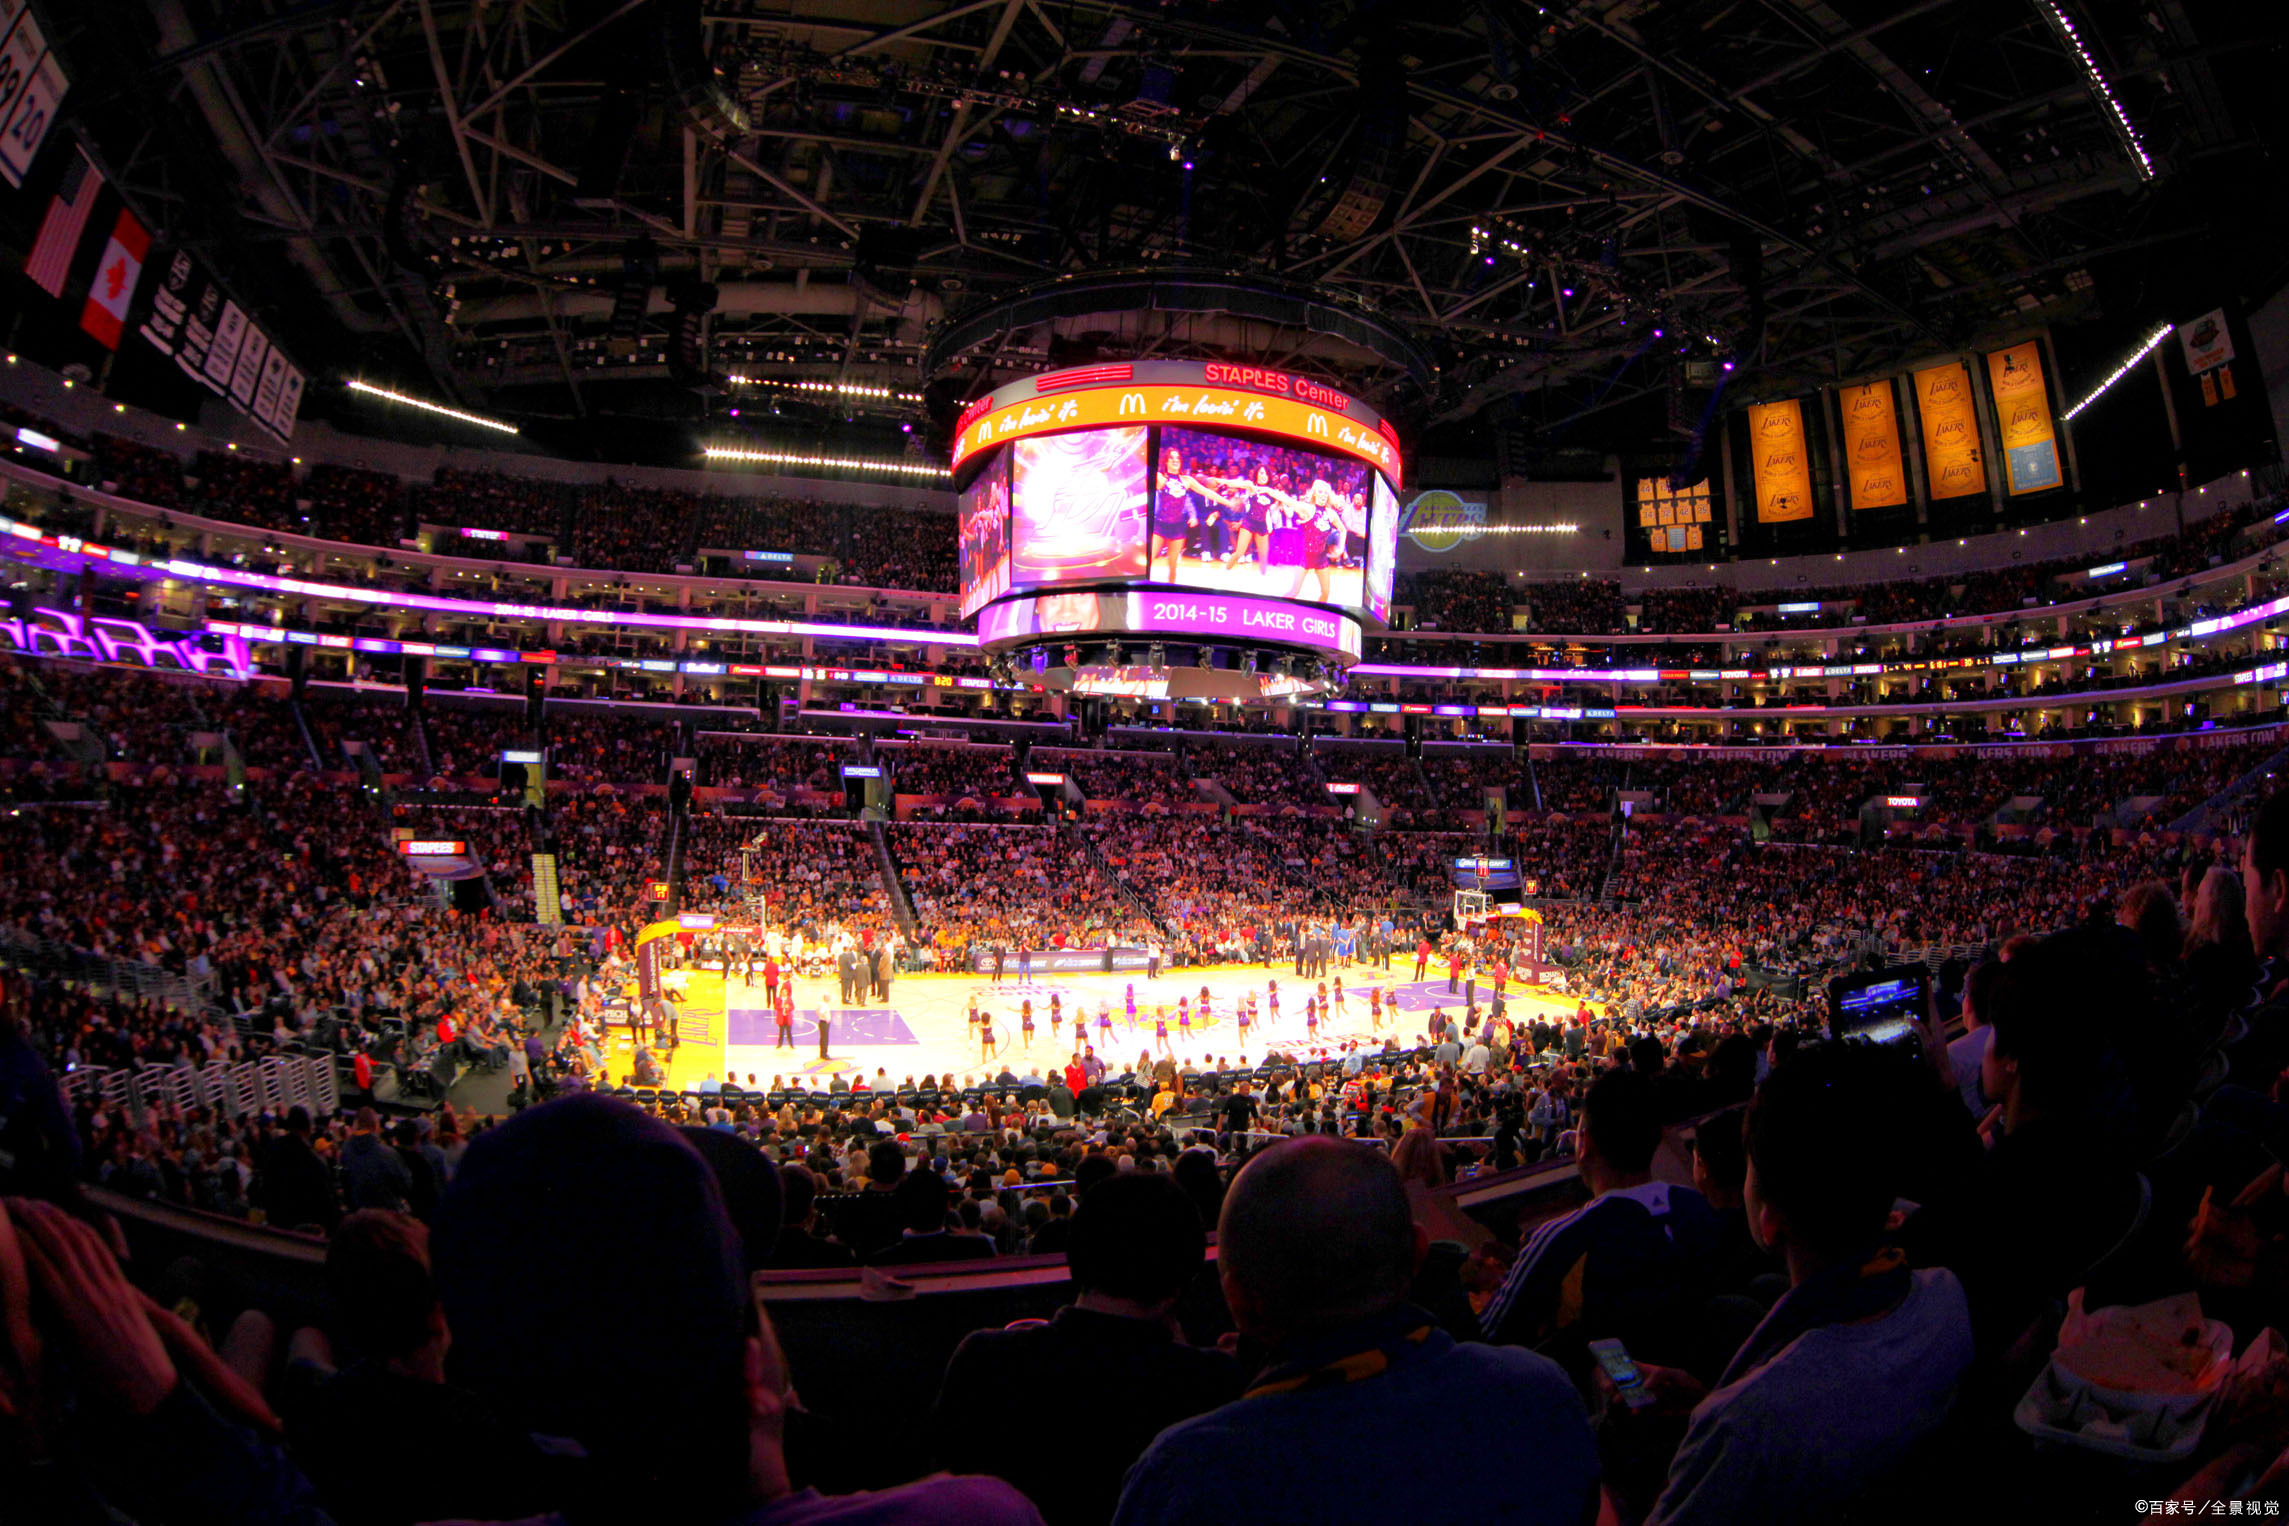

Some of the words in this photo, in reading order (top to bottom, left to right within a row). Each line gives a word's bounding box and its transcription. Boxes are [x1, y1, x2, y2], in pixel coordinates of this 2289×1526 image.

[1205, 363, 1290, 392] STAPLES
[1294, 378, 1350, 410] Center
[1929, 380, 1958, 396] LAKERS
[1853, 399, 1882, 412] LAKERS
[1761, 415, 1792, 430] LAKERS
[2011, 411, 2040, 426] LAKERS
[1935, 422, 1965, 437] LAKERS
[1766, 455, 1797, 468] LAKERS
[1942, 466, 1972, 481] LAKERS
[1863, 479, 1893, 493] LAKERS
[1153, 603, 1228, 623] 2014-15
[1242, 608, 1295, 630] LAKER
[1302, 617, 1336, 638] GIRLS
[961, 679, 990, 688] STAPLES
[1888, 797, 1917, 806] TOYOTA
[409, 842, 456, 854] STAPLES
